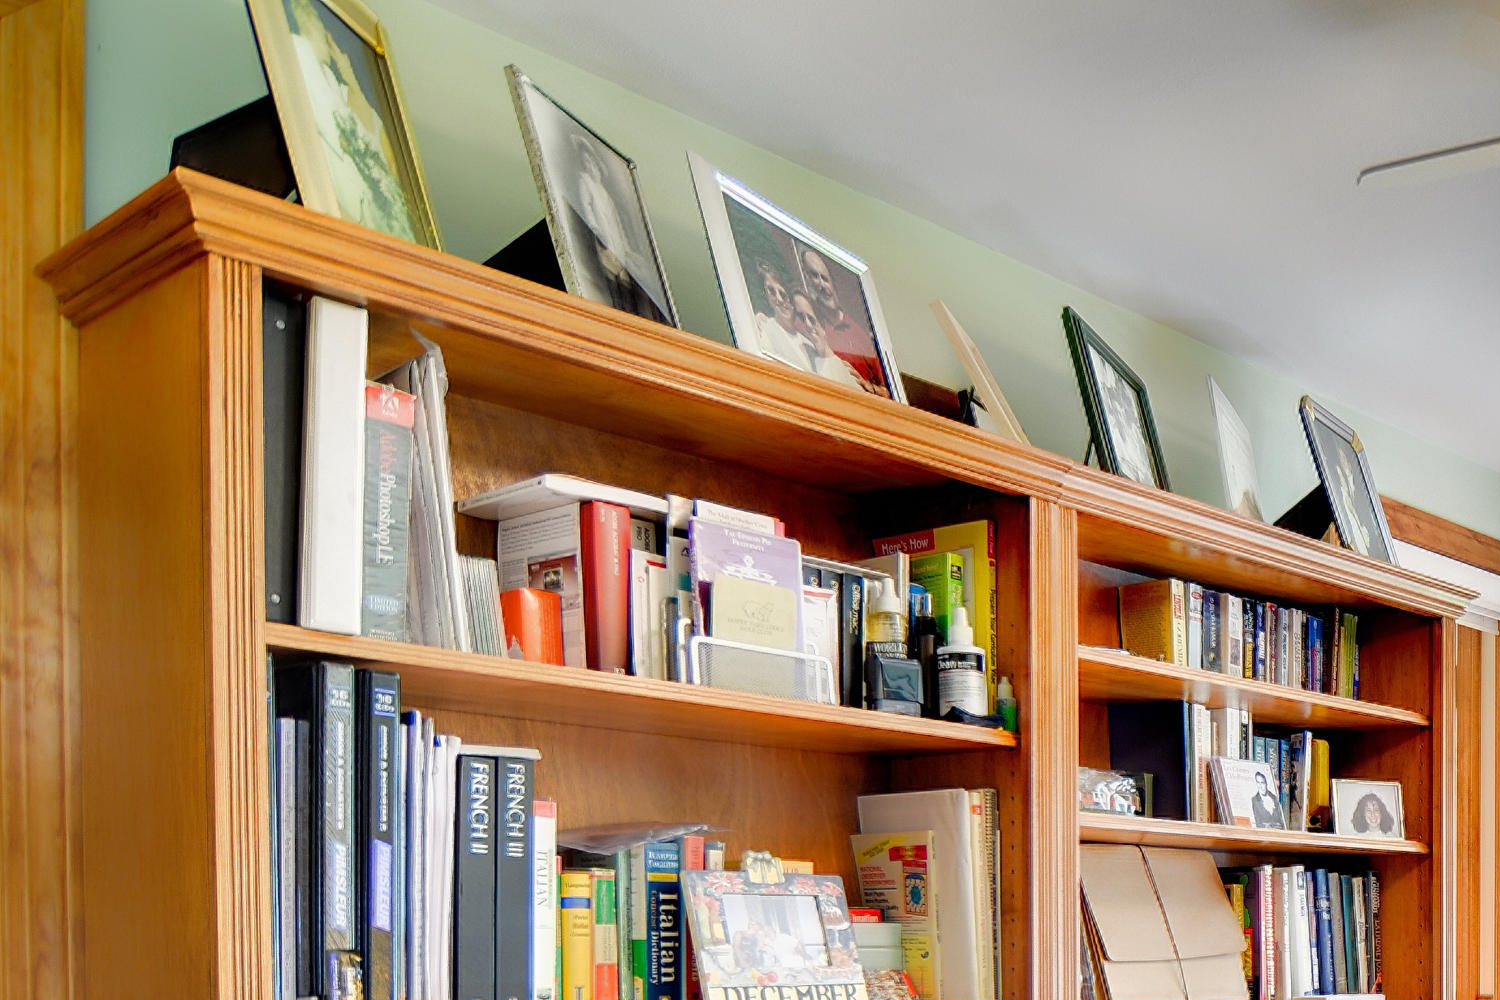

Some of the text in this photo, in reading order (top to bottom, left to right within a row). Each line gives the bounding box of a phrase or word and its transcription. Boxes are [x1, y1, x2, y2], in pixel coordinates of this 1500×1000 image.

[380, 431, 396, 472] Adobe
[373, 473, 395, 546] Photoshop
[882, 538, 928, 554] Here's How
[471, 763, 488, 854] FRENCH II
[506, 763, 524, 857] FRENCH III
[334, 844, 347, 925] PIMSLEUR
[378, 846, 391, 924] PIMSLEUR
[536, 851, 548, 907] ITALIAN
[650, 931, 659, 985] Dictionary
[659, 892, 678, 984] Italian
